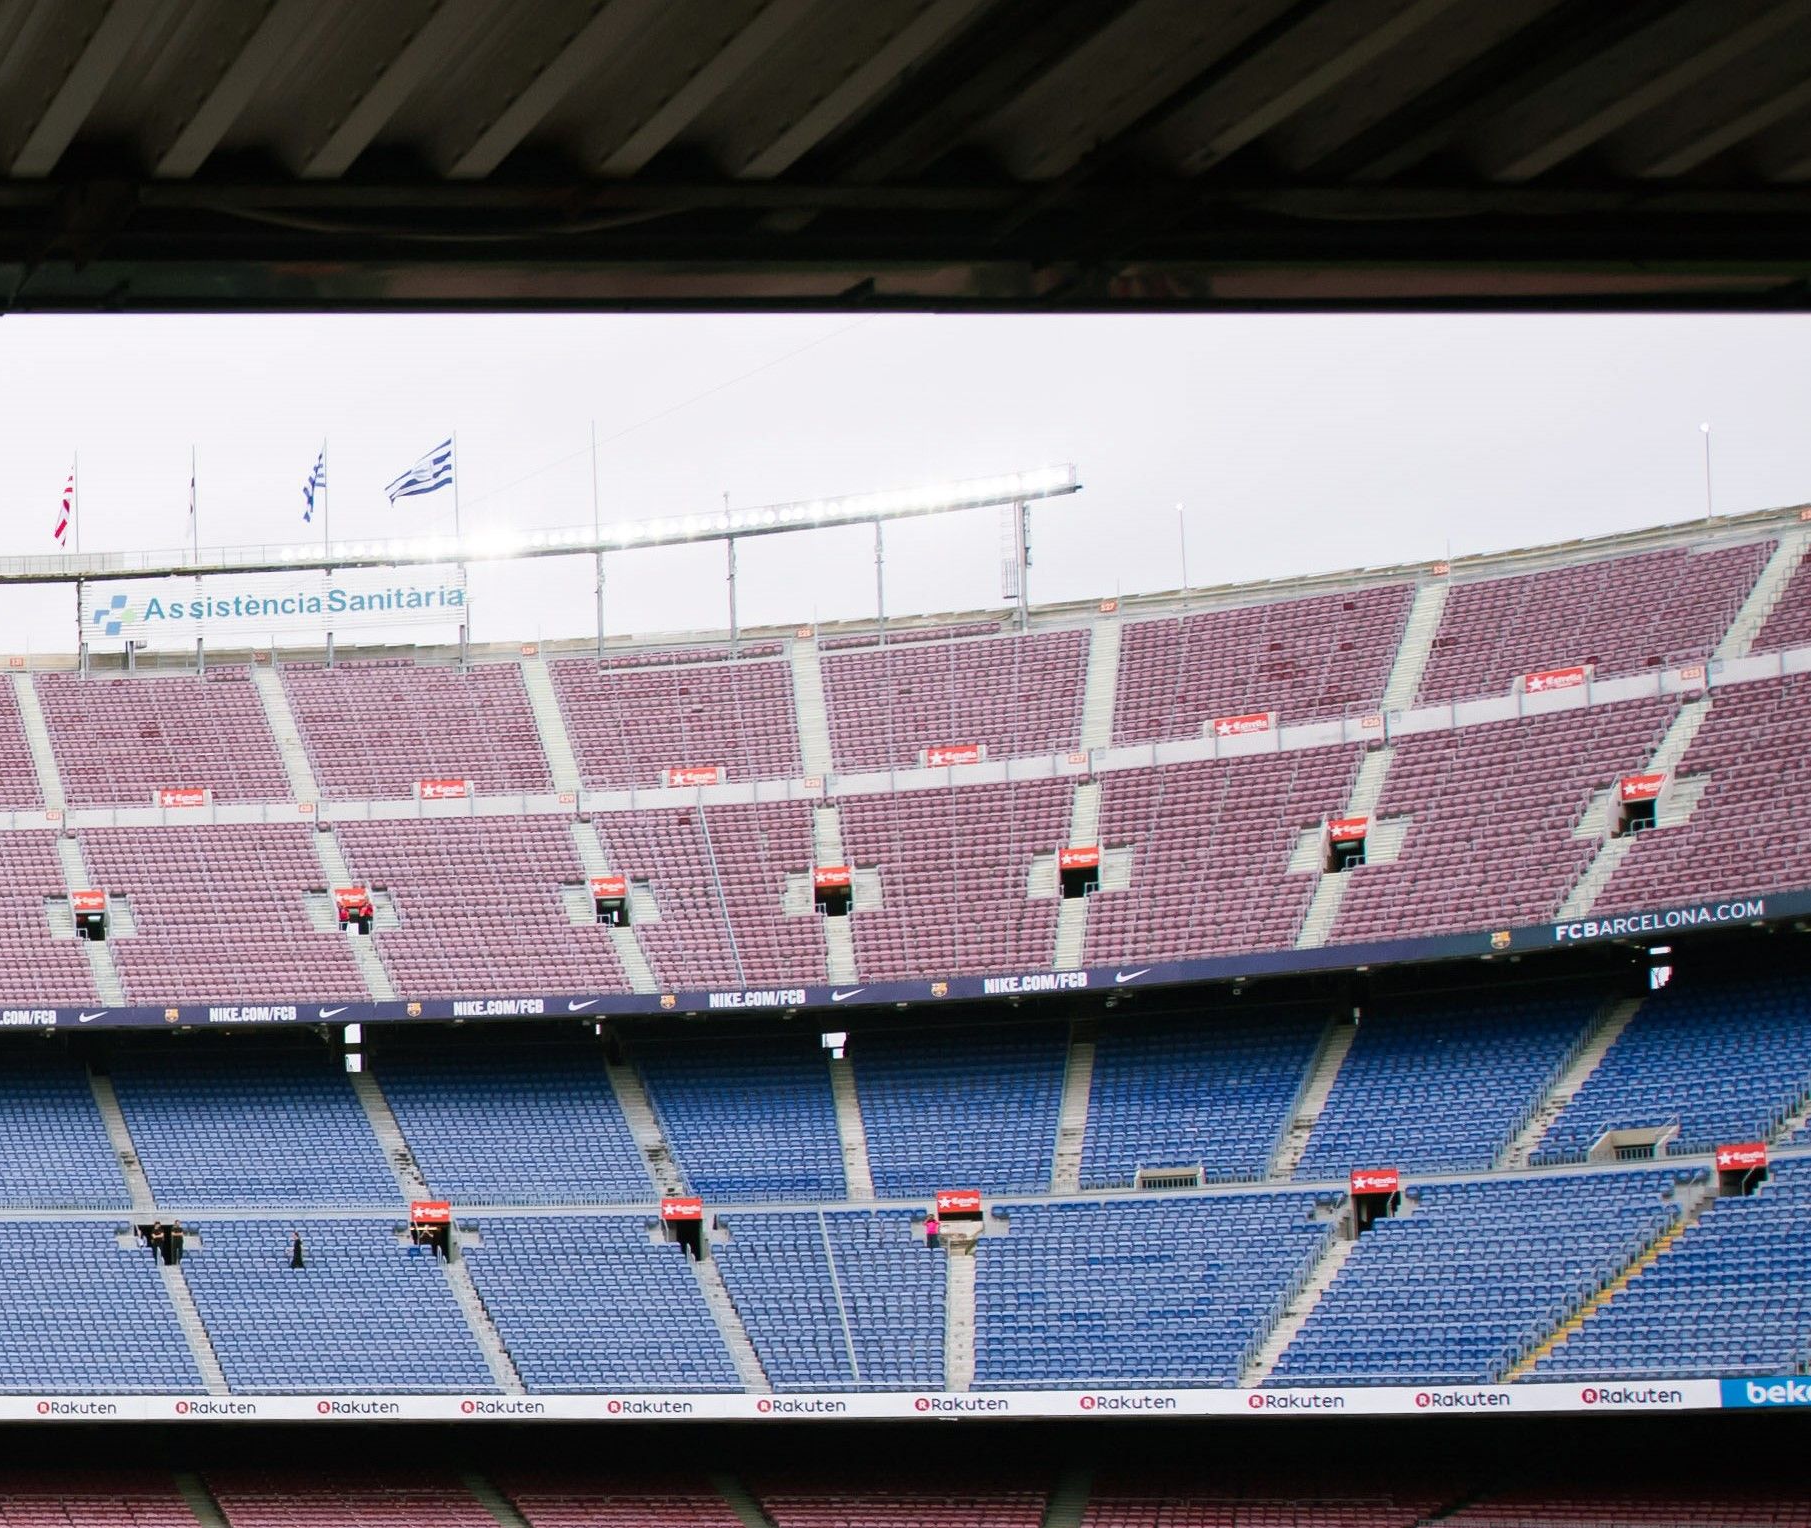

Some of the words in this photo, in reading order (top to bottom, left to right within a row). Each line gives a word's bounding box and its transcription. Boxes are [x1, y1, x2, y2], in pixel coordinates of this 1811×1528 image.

[144, 593, 322, 622] Assistència
[327, 586, 465, 614] Sanitària
[984, 971, 1087, 994] NIKE.COM/FCB
[709, 988, 806, 1008] NIKE.COM/FCB
[209, 1005, 297, 1021] NIKE.COM/FCB
[453, 998, 544, 1016] NIKE.COM/FCB
[1267, 1395, 1344, 1408] Rakuten
[1433, 1392, 1510, 1406] Rakuten
[1600, 1388, 1682, 1403] Rakuten
[52, 1402, 116, 1414] Rakuten
[190, 1401, 256, 1414] Rakuten
[332, 1401, 398, 1413] Rakuten
[476, 1400, 544, 1413] Rakuten
[623, 1400, 692, 1413] Rakuten
[773, 1400, 845, 1412] Rakuten
[932, 1398, 1008, 1410] Rakuten
[1098, 1396, 1176, 1409] Rakuten
